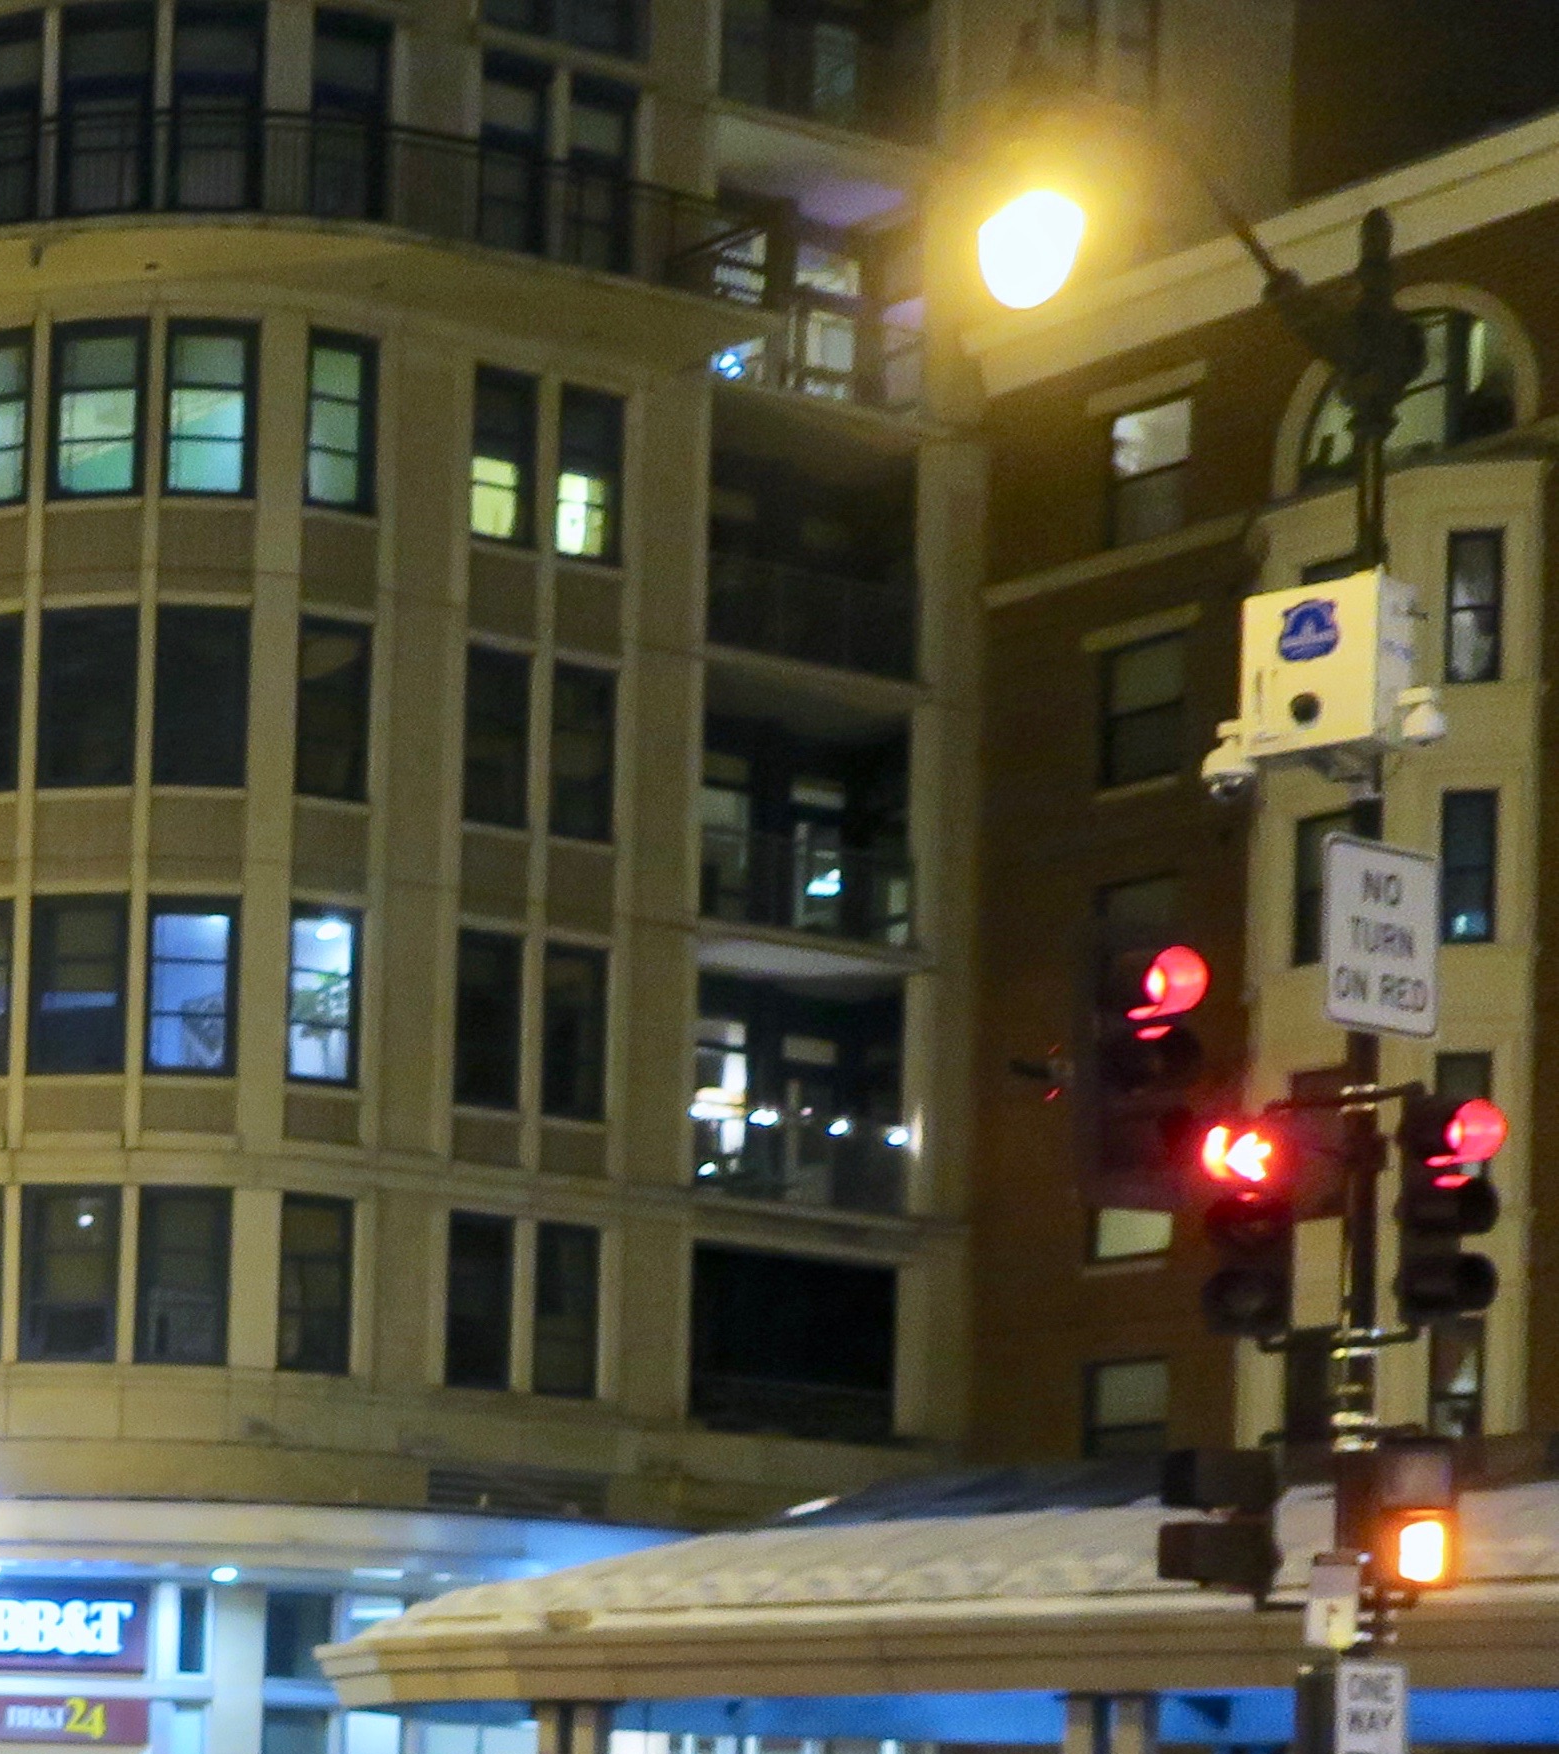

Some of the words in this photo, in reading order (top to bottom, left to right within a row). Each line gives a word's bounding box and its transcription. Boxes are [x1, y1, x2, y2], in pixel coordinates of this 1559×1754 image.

[1362, 869, 1402, 907] NO
[1348, 914, 1415, 959] TURN
[1335, 963, 1368, 1002] ON
[1380, 972, 1428, 1013] RED
[1348, 1674, 1393, 1704] ONE
